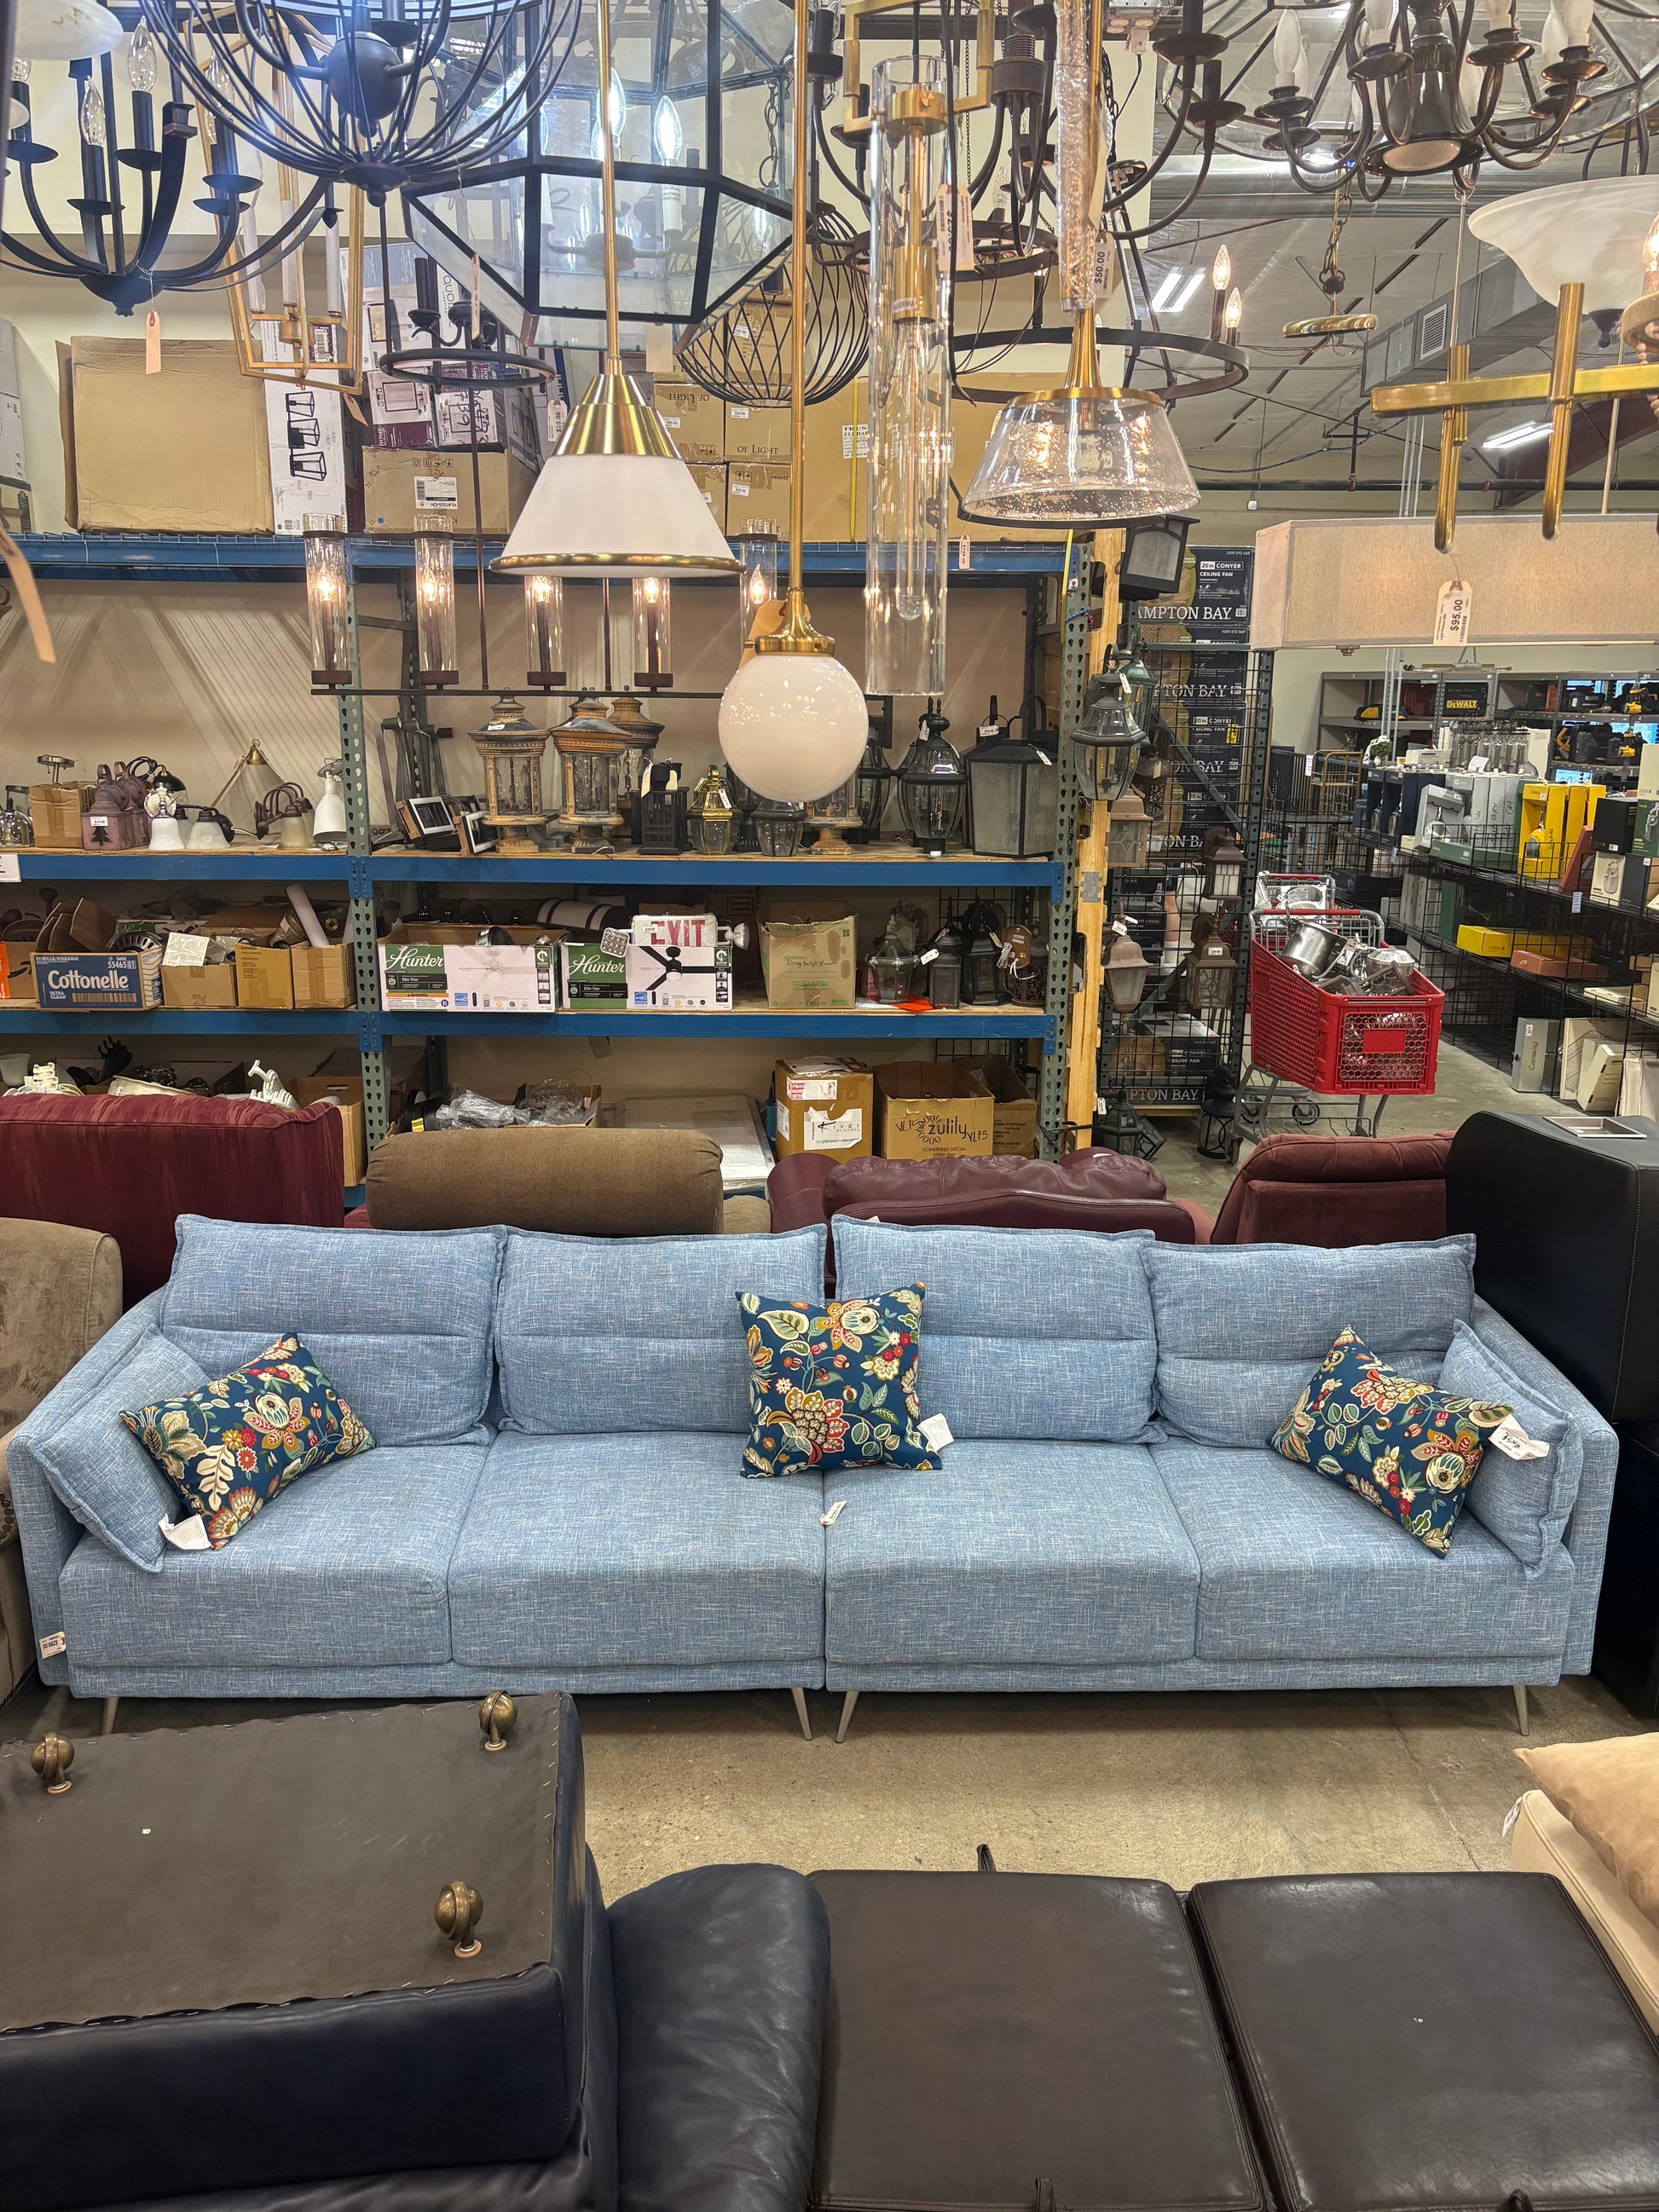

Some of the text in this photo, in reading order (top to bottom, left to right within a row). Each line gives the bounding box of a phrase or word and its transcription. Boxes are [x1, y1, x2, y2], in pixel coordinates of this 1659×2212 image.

[1095, 251, 1105, 284] $50.00
[668, 394, 694, 403] LIGHT
[752, 444, 779, 453] LIGHT
[1203, 607, 1233, 620] BAY
[1450, 599, 1463, 631] $95.00
[1198, 684, 1227, 697] BAY
[1446, 700, 1477, 709] DEWALT
[650, 920, 706, 948] EXIT
[107, 961, 127, 969] 55465
[384, 948, 444, 970] Hunter
[567, 955, 626, 977] Hunter
[48, 970, 130, 989] Cottonelle
[1528, 1042, 1539, 1071] Caraway
[1172, 1089, 1199, 1100] BAY
[928, 1116, 967, 1139] zulily
